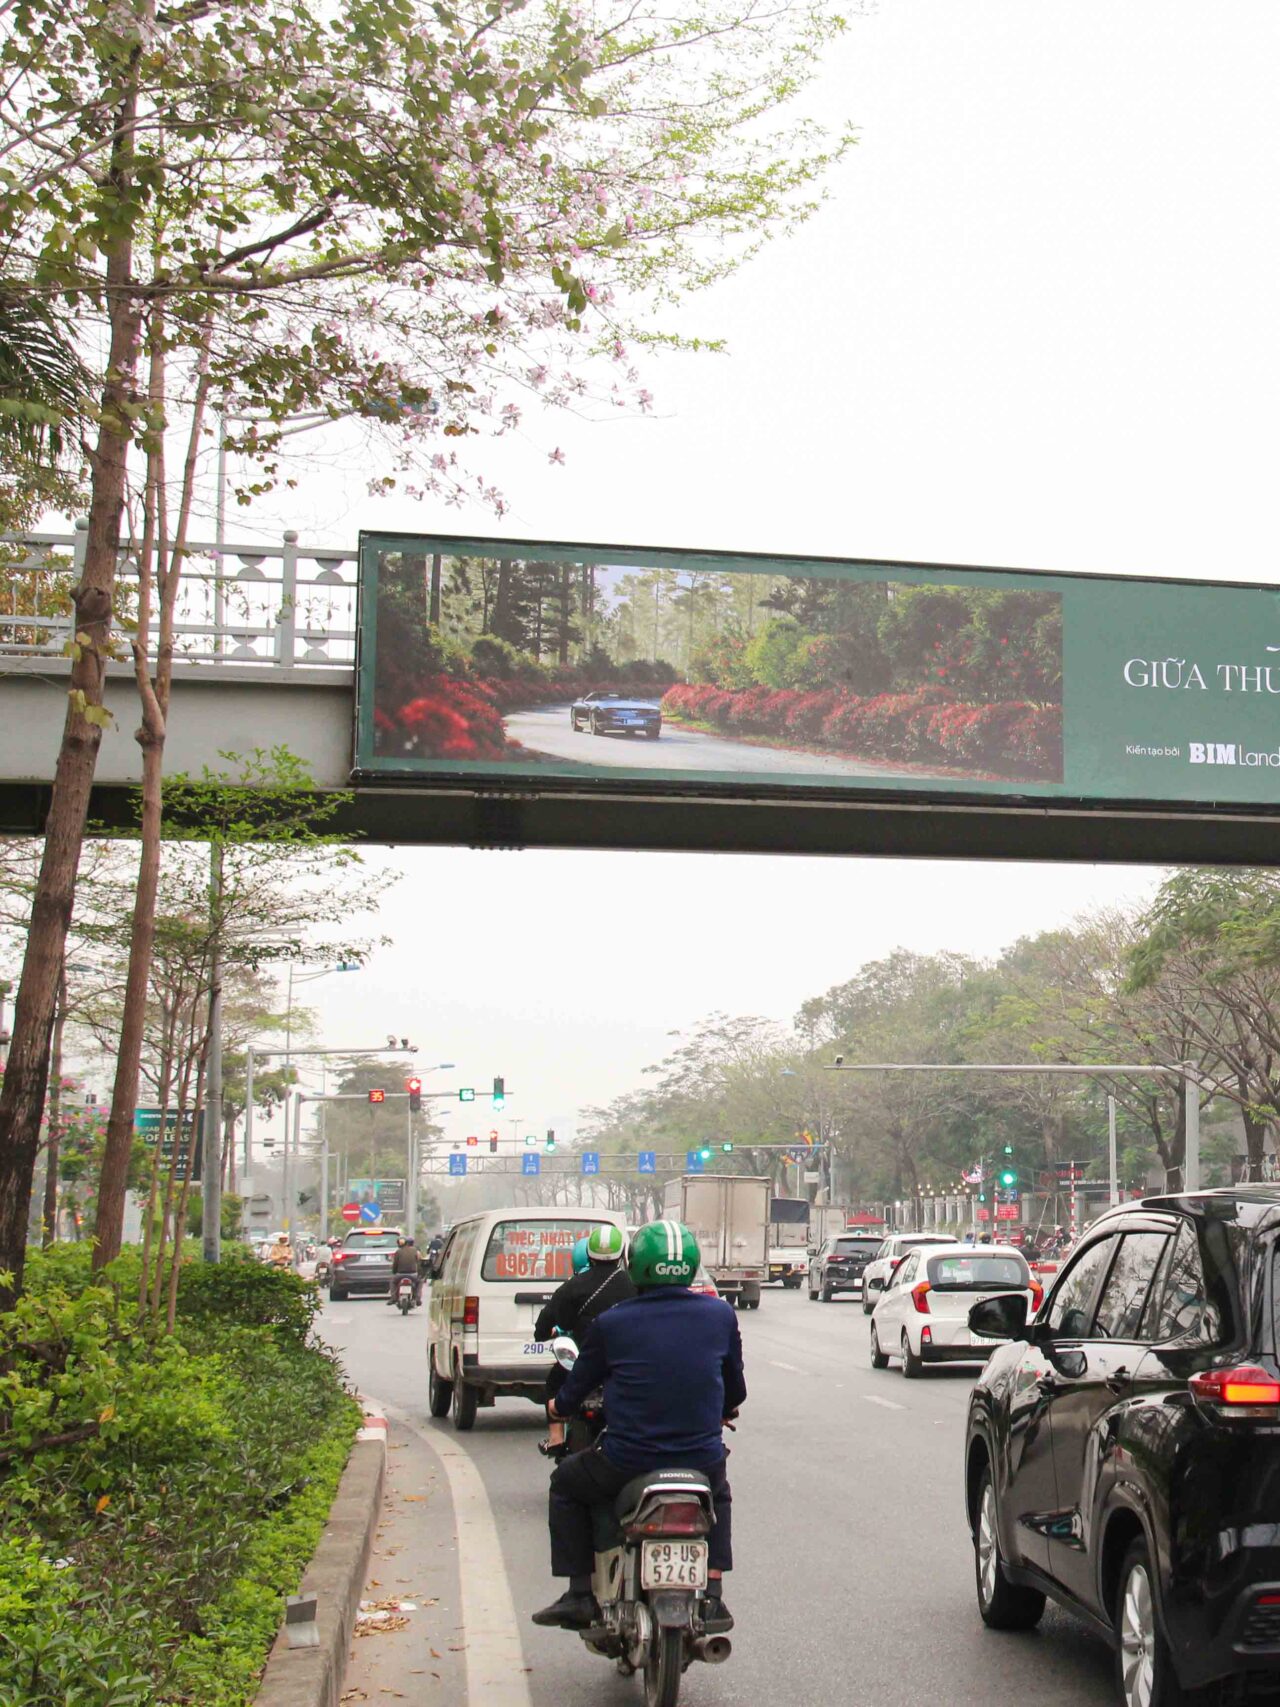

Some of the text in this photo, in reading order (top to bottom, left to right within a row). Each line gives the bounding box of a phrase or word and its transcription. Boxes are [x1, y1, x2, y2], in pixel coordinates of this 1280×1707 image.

[1123, 657, 1208, 690] GIỮA
[1148, 746, 1163, 758] tạo
[656, 1262, 690, 1276] Grab
[653, 1565, 697, 1583] 5246
